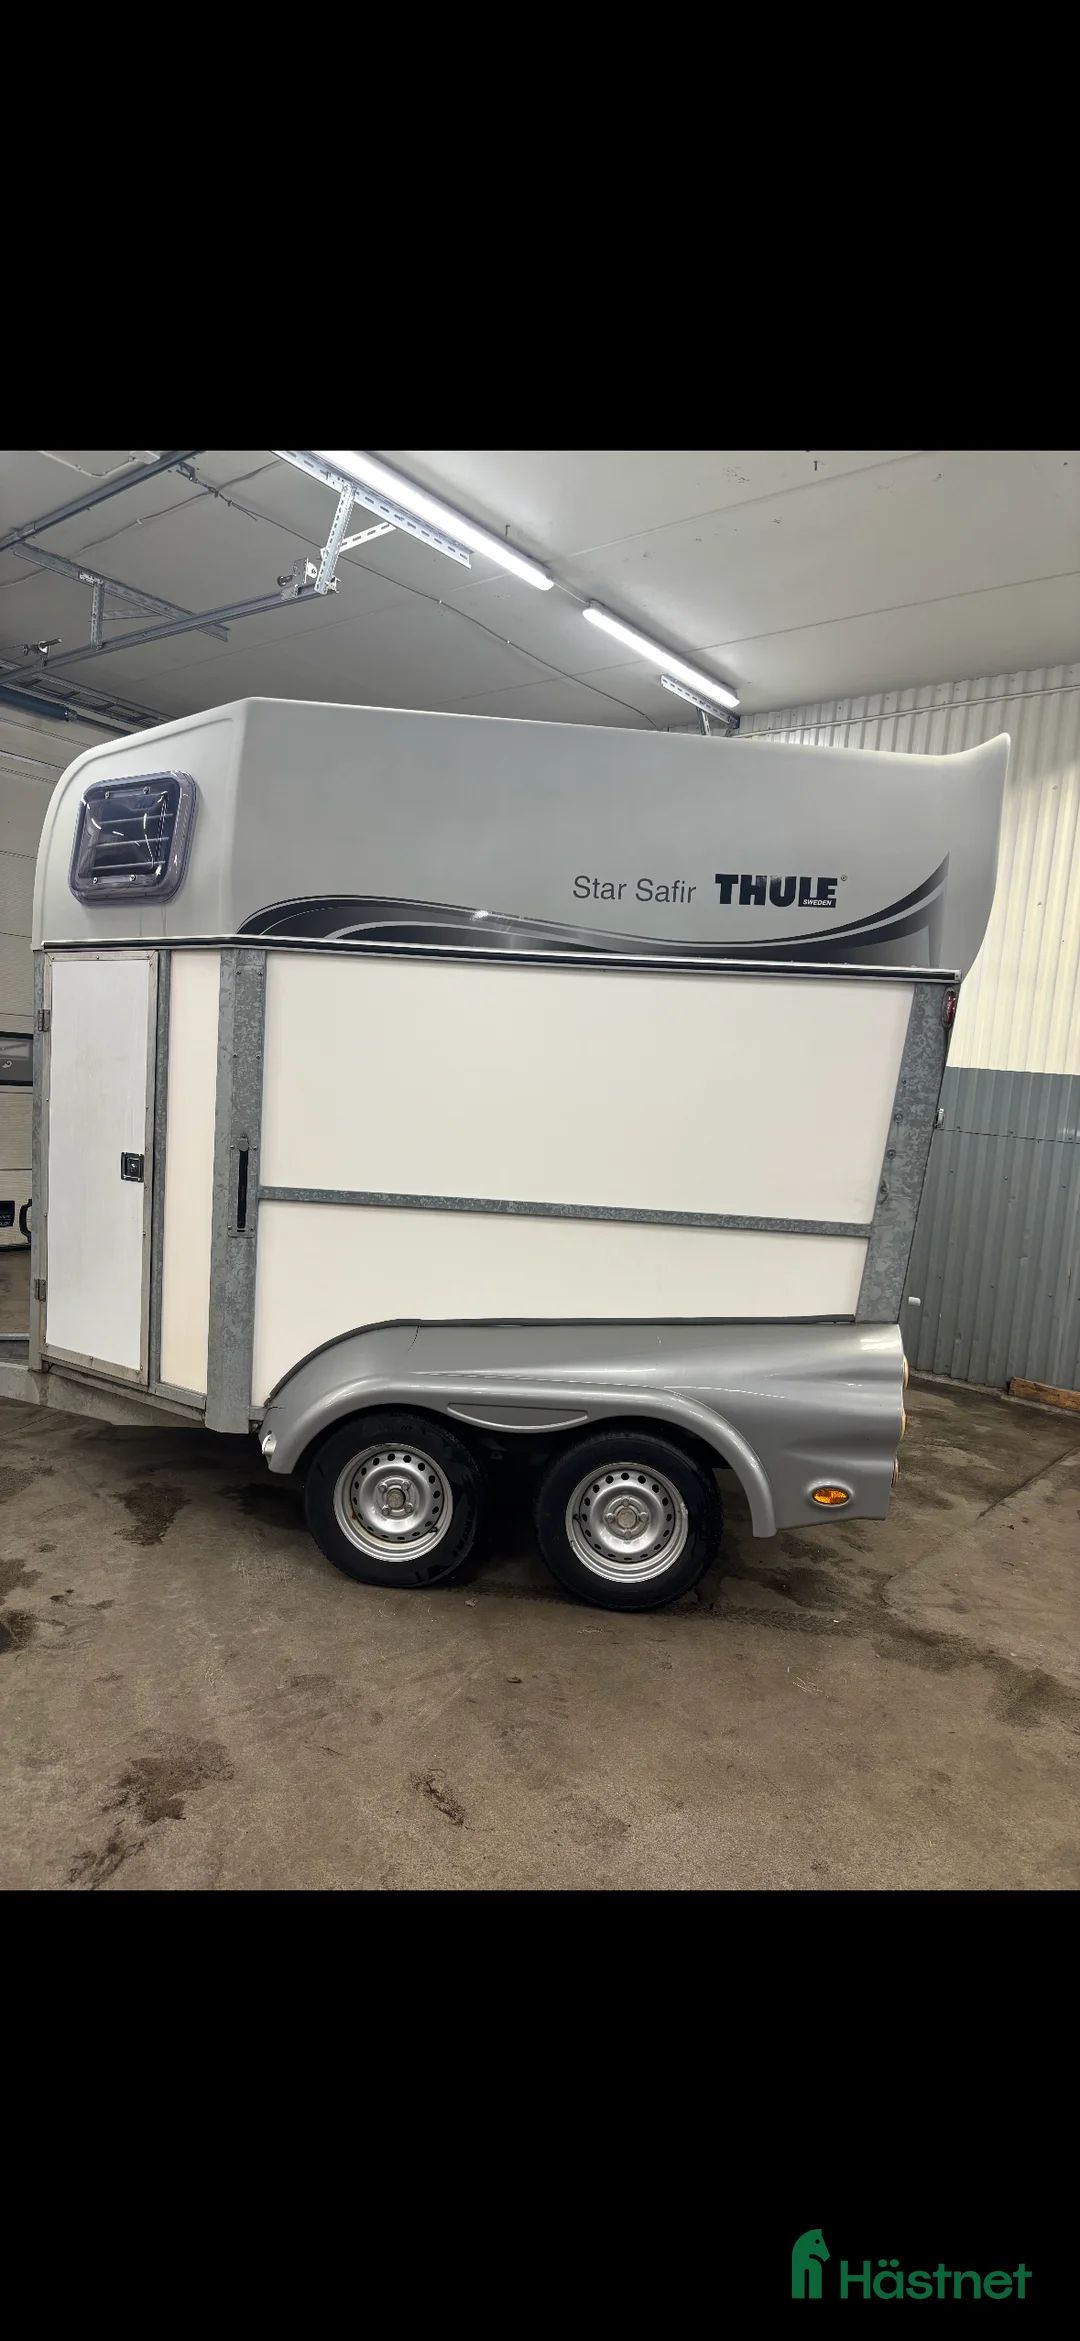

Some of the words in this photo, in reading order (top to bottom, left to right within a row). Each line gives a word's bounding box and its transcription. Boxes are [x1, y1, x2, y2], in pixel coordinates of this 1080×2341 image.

[573, 875, 627, 900] Star
[635, 877, 697, 904] Safir
[715, 873, 838, 908] THULE
[802, 898, 833, 906] SWEDEN
